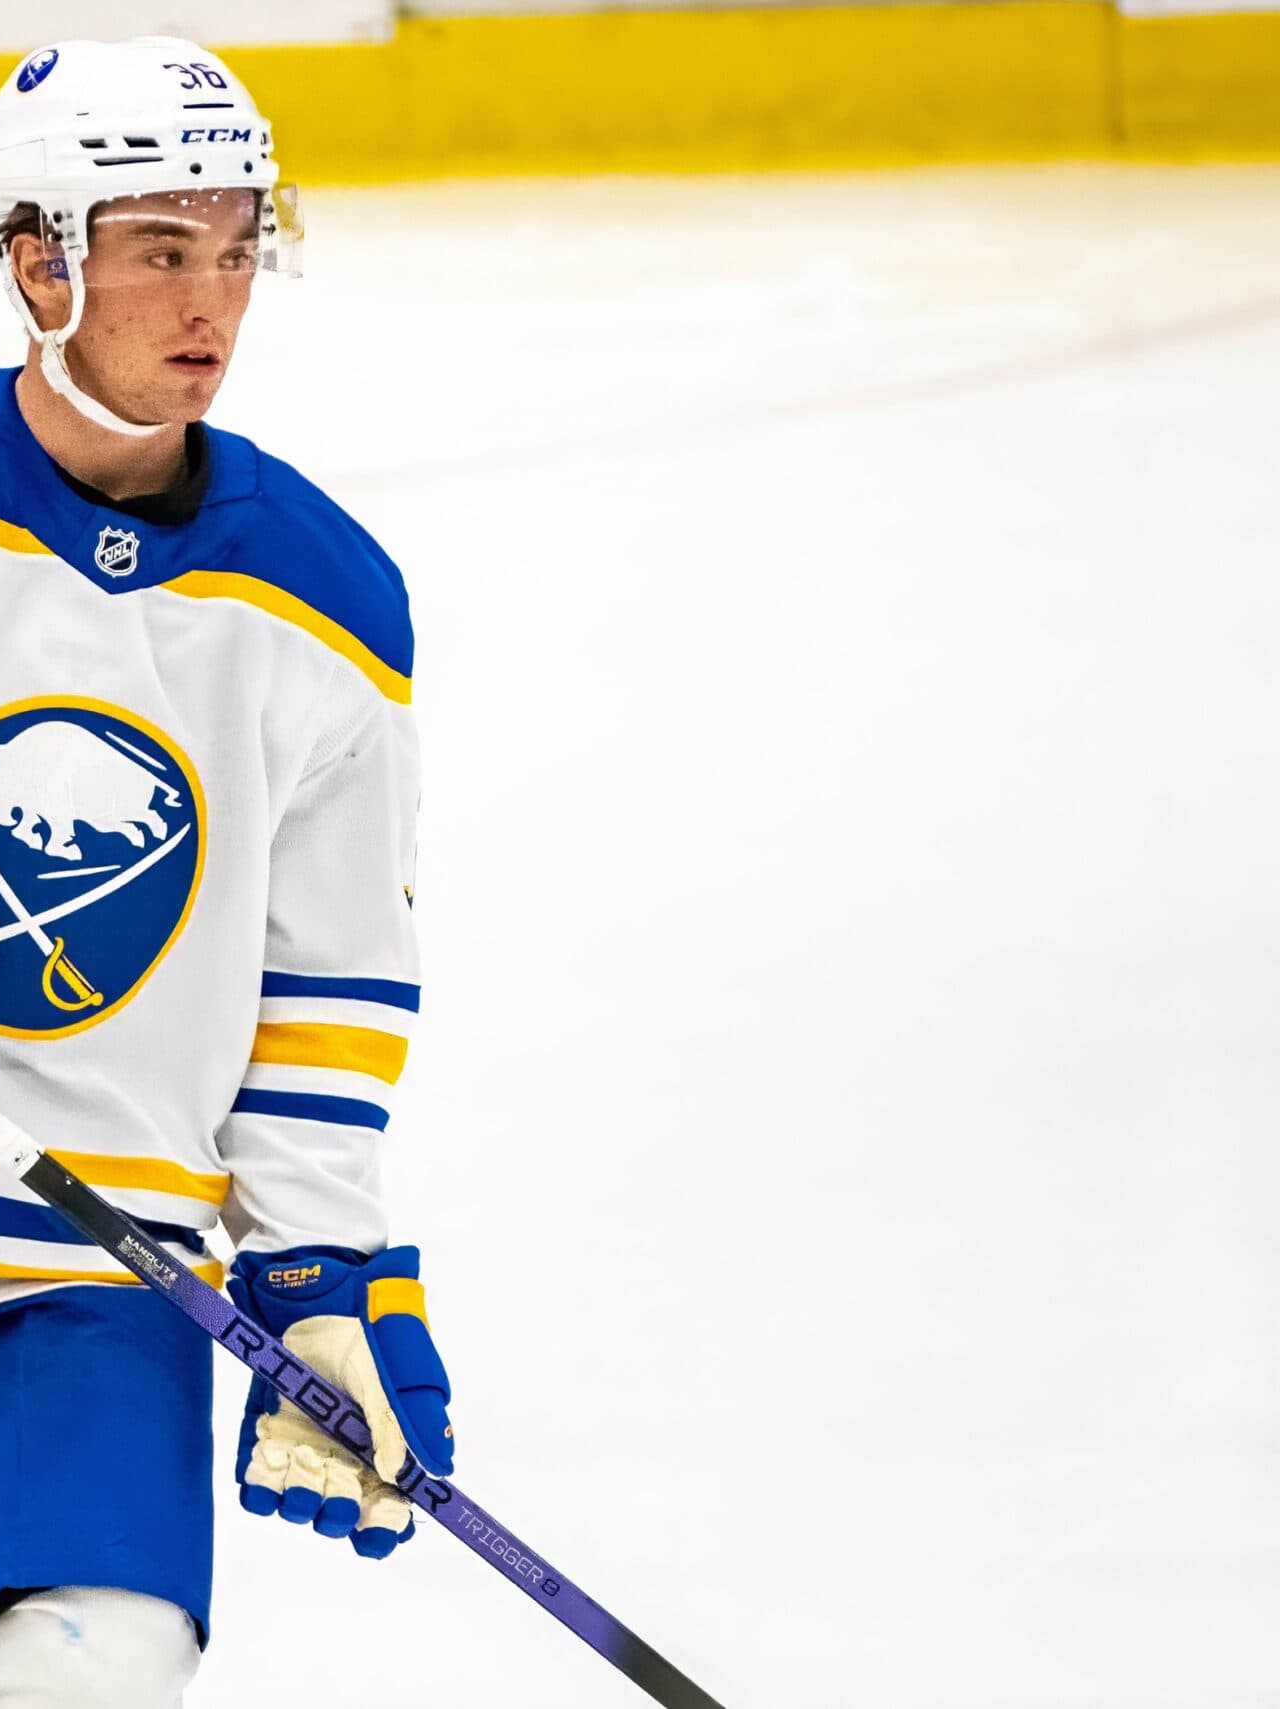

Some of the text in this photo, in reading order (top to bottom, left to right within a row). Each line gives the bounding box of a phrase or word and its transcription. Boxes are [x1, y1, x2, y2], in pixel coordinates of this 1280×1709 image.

[162, 62, 227, 90] 36
[181, 128, 251, 143] CCM
[103, 542, 131, 567] NHL
[268, 1264, 321, 1282] CCM
[458, 1505, 544, 1583] TRIGGER
